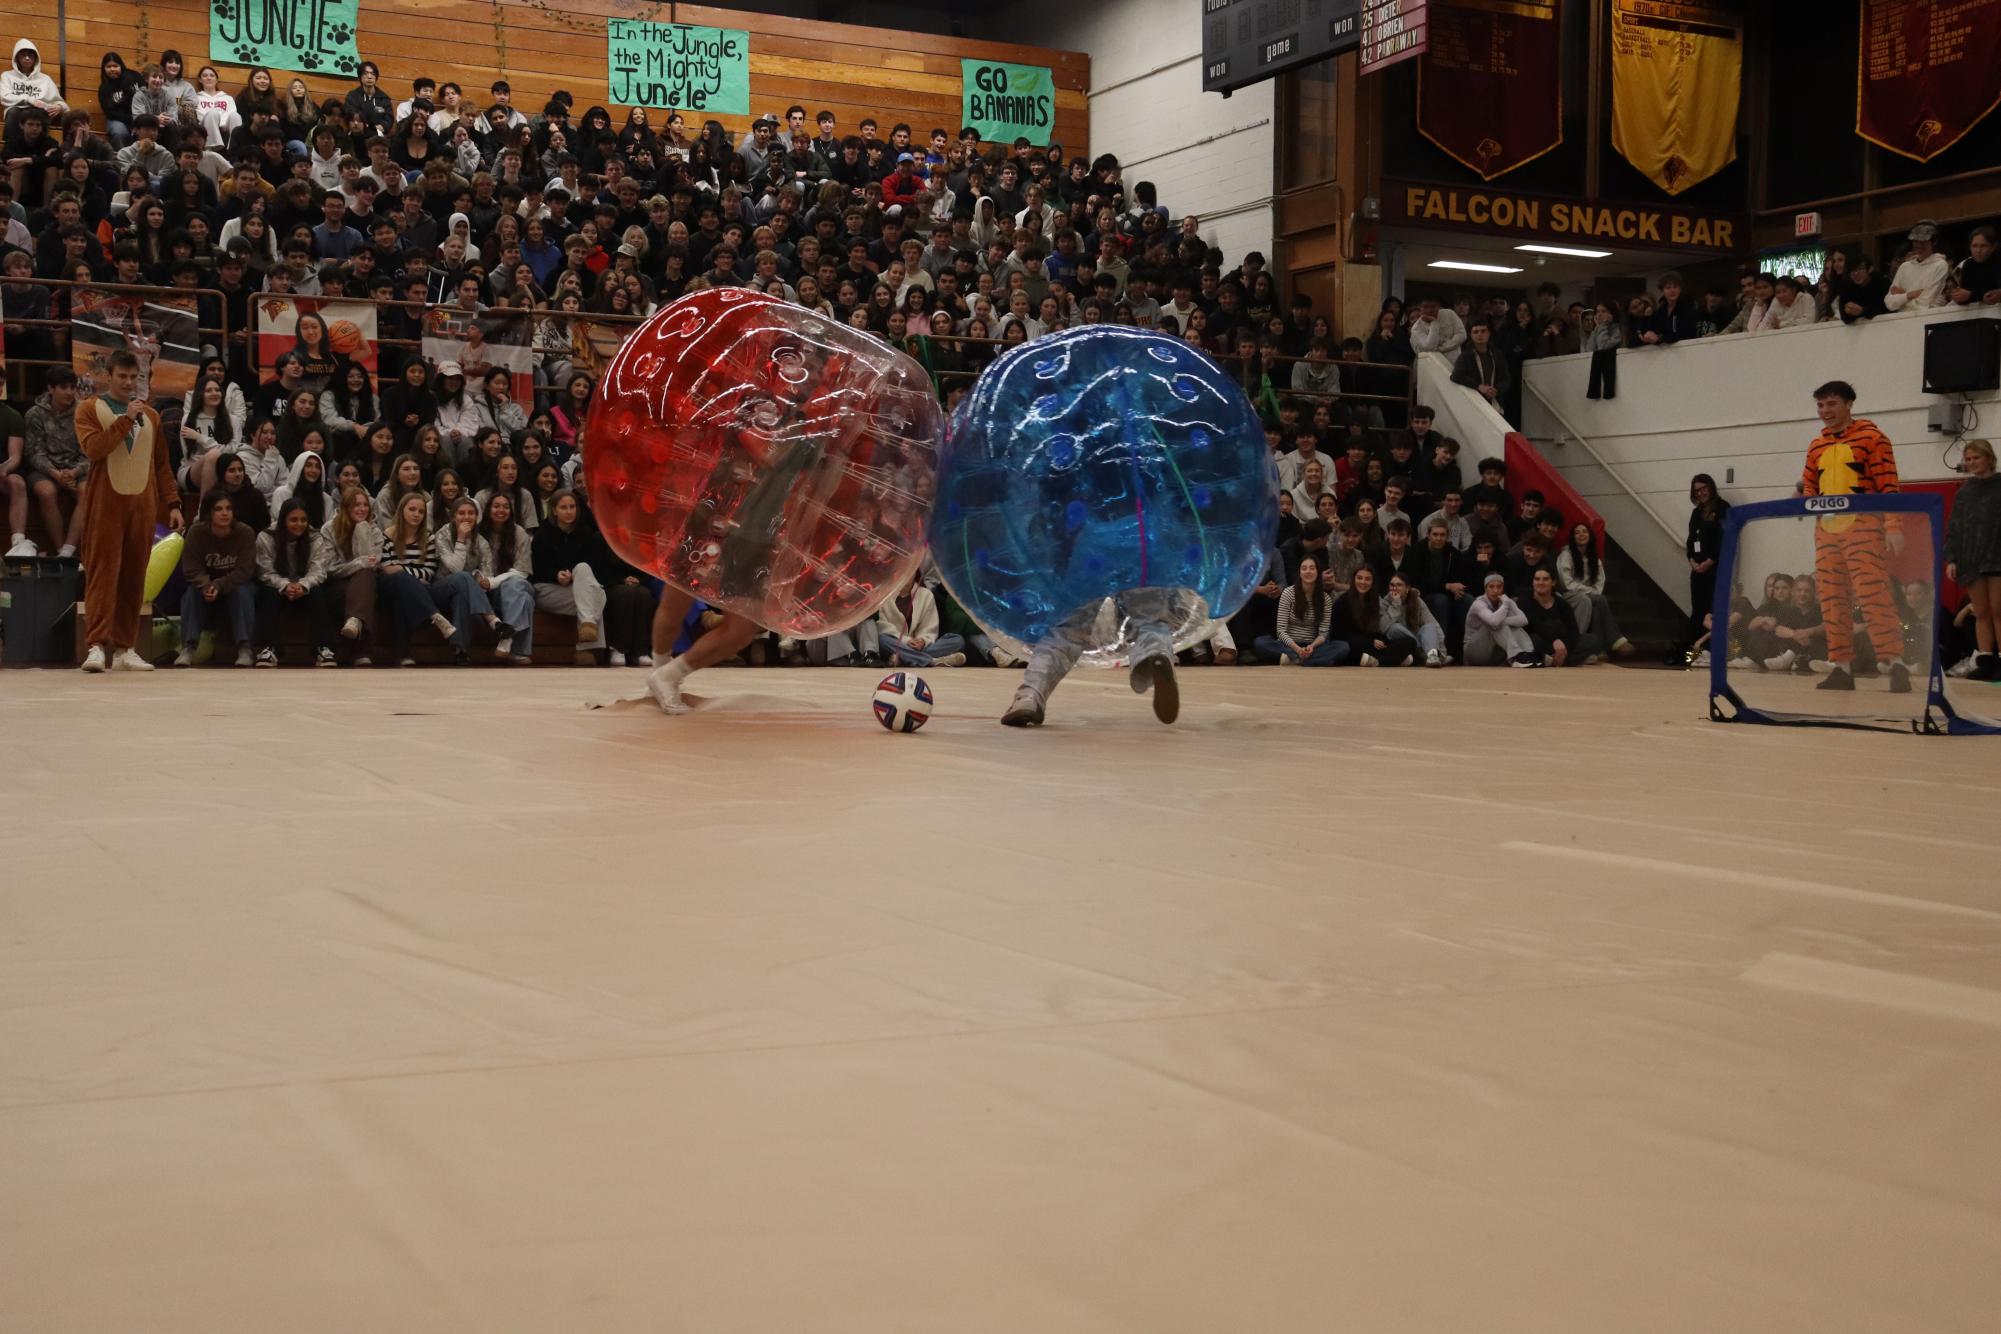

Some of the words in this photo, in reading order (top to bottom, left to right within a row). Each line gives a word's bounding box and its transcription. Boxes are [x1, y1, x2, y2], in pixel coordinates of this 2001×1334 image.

[1334, 17, 1353, 36] won
[1362, 30, 1372, 47] 41
[1377, 16, 1404, 42] OBRIEN
[1363, 11, 1373, 28] 25
[609, 21, 637, 40] In
[640, 23, 673, 43] the
[673, 25, 743, 69] Jungle,
[1266, 38, 1290, 63] game
[1361, 47, 1373, 65] 42
[614, 48, 641, 65] the
[647, 48, 721, 95] Mighty
[975, 66, 1007, 93] GO
[1209, 61, 1226, 79] won
[971, 94, 1049, 127] BANANAS
[1407, 188, 1539, 230] FALCON
[1549, 202, 1661, 241] SNACK
[1671, 215, 1734, 248] BAR
[1798, 216, 1813, 233] EXIT
[1811, 497, 1845, 509] PUGG
